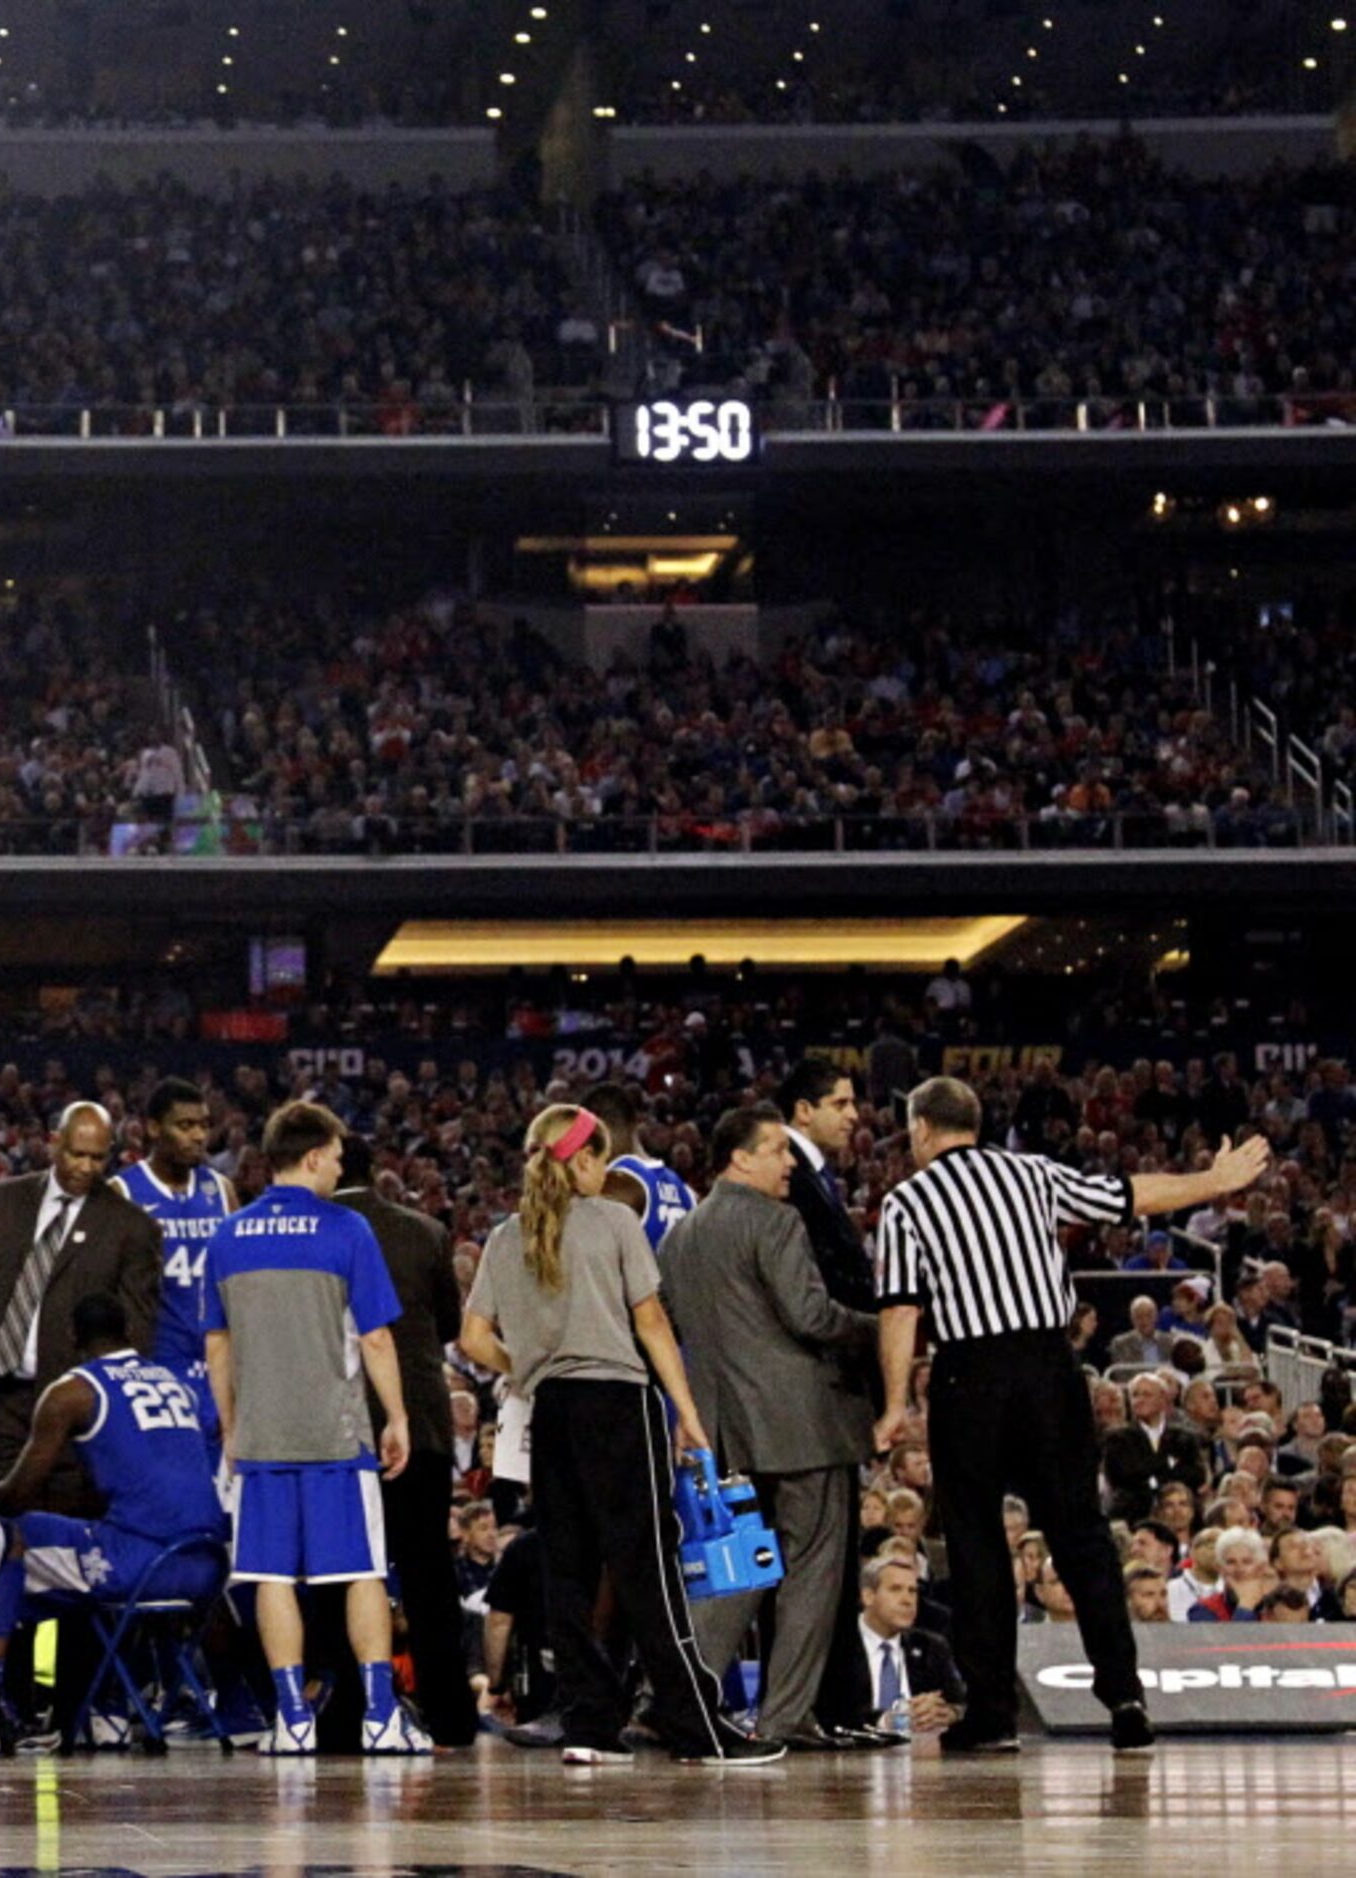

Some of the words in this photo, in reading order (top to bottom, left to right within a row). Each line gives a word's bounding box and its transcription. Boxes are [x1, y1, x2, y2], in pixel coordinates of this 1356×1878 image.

[636, 401, 752, 461] 13:50
[235, 1215, 320, 1237] KENTUCKY
[122, 1380, 200, 1431] 22
